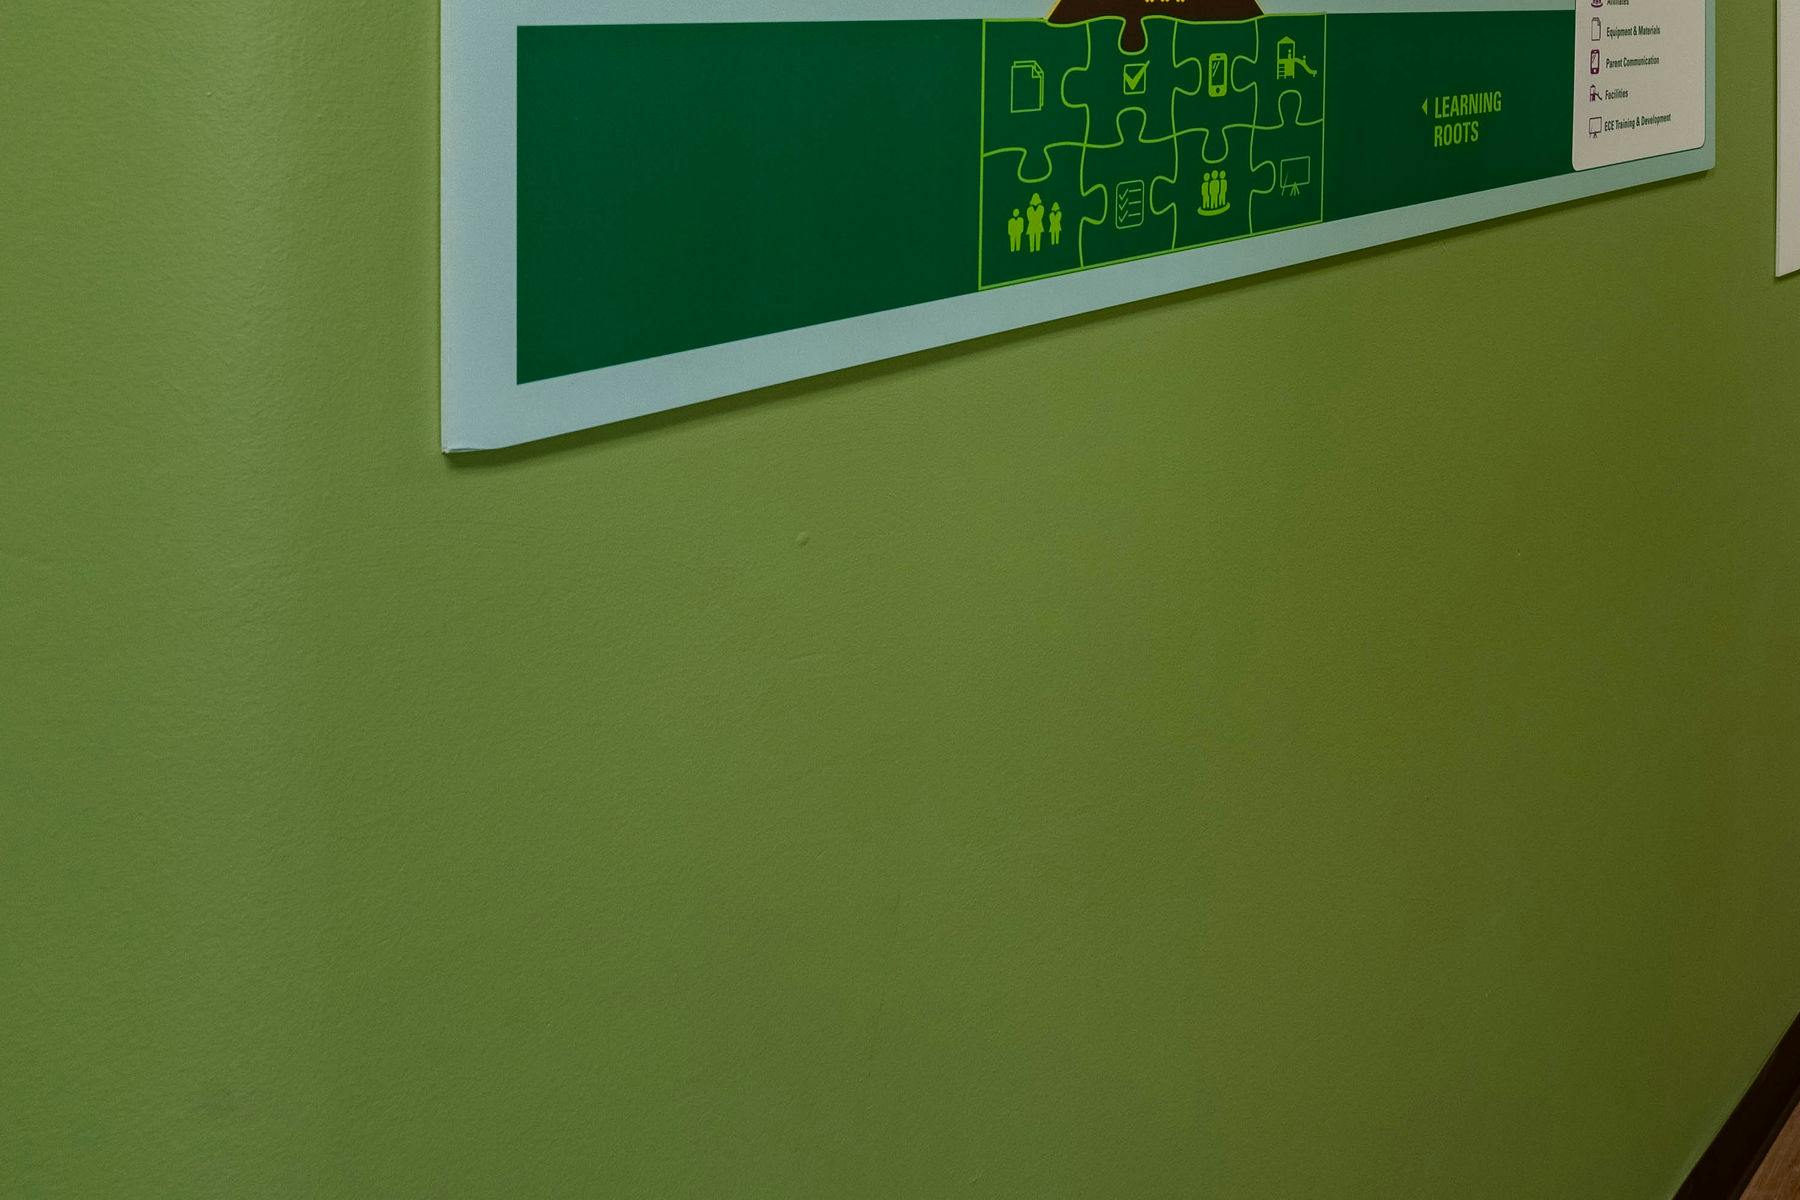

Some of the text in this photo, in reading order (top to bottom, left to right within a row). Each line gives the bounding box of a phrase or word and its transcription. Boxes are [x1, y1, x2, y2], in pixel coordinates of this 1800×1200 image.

[1606, 26, 1633, 39] Equipment
[1638, 25, 1660, 36] Materials
[1606, 55, 1659, 69] Parent Communication
[1605, 89, 1628, 100] Facilities
[1434, 90, 1502, 118] LEARNING
[1604, 120, 1614, 132] ECE
[1616, 117, 1635, 131] Training
[1641, 113, 1671, 128] Development
[1434, 122, 1479, 147] ROOTS
